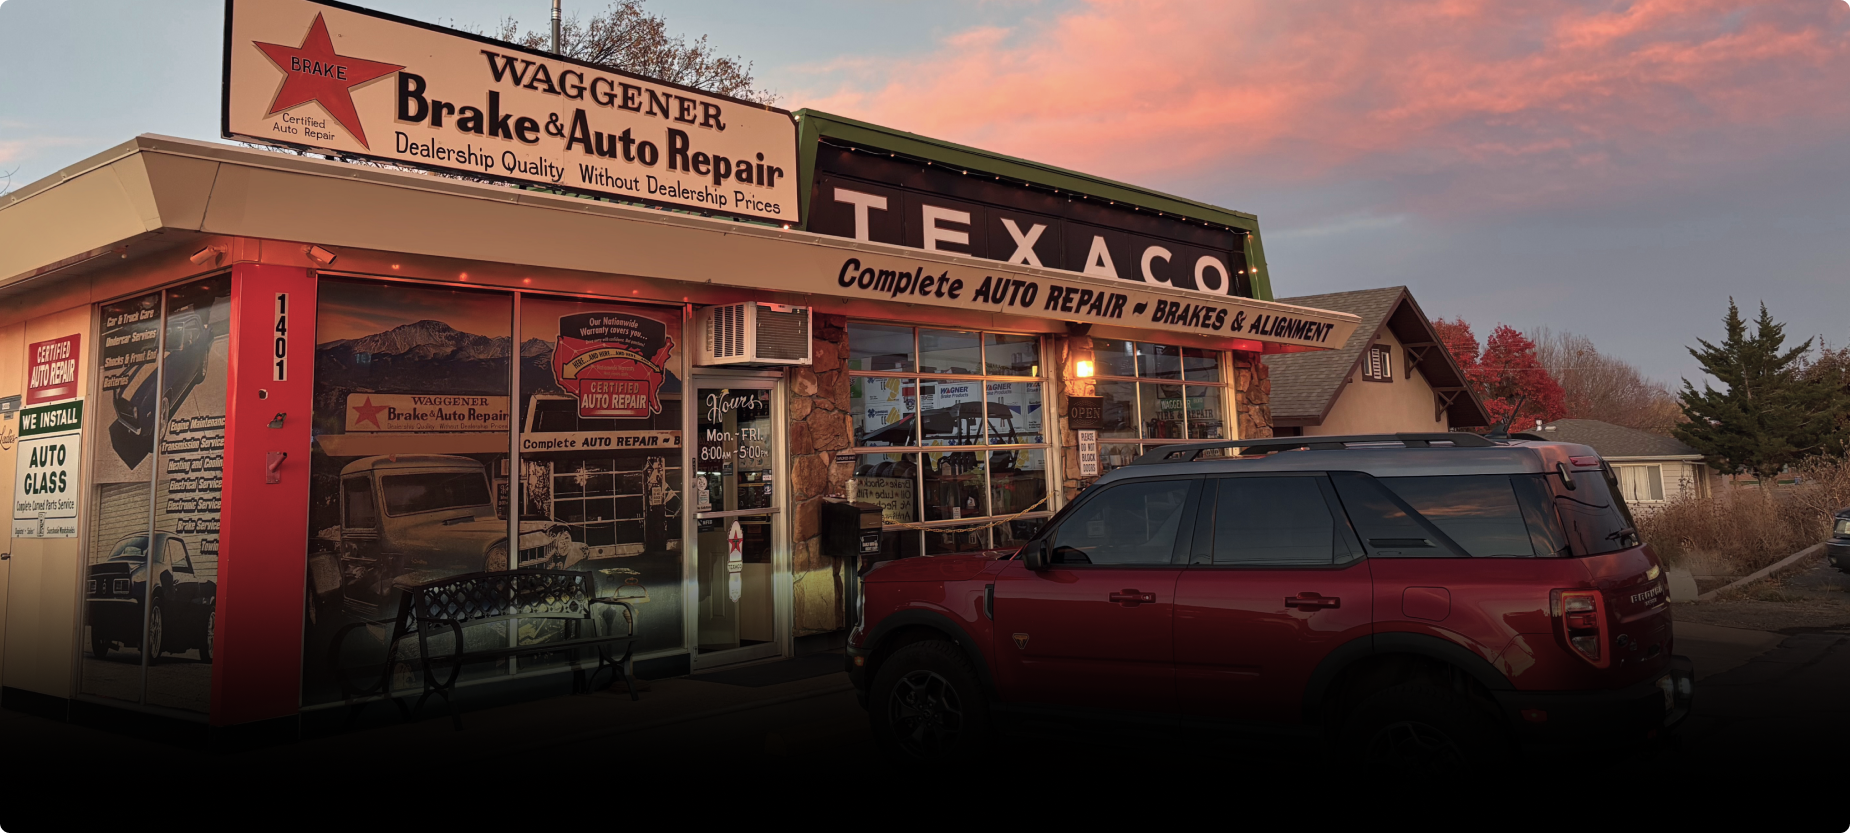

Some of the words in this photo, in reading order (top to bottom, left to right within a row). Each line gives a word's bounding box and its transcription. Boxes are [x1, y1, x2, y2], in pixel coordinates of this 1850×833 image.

[291, 55, 348, 81] BRAKE
[480, 49, 726, 131] WAGGENER
[282, 112, 326, 130] Certified
[396, 72, 541, 145] Brake
[566, 108, 659, 167] Auto
[667, 128, 784, 188] Repair
[272, 121, 299, 138] Auto
[304, 126, 336, 142] Repair
[394, 132, 495, 176] Dealership
[501, 150, 564, 182] Quality
[579, 163, 640, 191] Without
[646, 175, 728, 208] Dealership
[734, 190, 781, 214] Prices
[834, 188, 1230, 297] TEXACO
[838, 258, 964, 300] Complete
[974, 275, 1038, 308] AUTO
[1044, 284, 1128, 319] REPAIR
[1151, 299, 1228, 332] BRAKES
[1230, 310, 1248, 333] &
[1250, 313, 1335, 344] ALIGNMENT
[106, 316, 118, 328] Car
[123, 311, 139, 324] Truck
[140, 308, 154, 320] Care
[589, 317, 602, 326] Our
[603, 316, 638, 329] Nationwide
[106, 332, 132, 348] Undercar
[131, 329, 157, 343] Services
[276, 293, 288, 381] 1401
[580, 326, 609, 337] Warranty
[37, 341, 70, 364] CERTIFIED
[104, 355, 124, 368] Shocks
[147, 348, 158, 360] End
[30, 364, 50, 388] AUTO
[50, 359, 76, 386] REPAIR
[103, 375, 130, 390] Batteries
[590, 382, 640, 394] CERTIFIED
[411, 396, 489, 406] WAGGENER
[581, 394, 609, 409] AUTO
[612, 394, 646, 409] REPAIR
[706, 393, 763, 425] Hours
[22, 413, 37, 430] WE
[40, 408, 78, 428] INSTALL
[388, 407, 428, 421] Brake
[436, 408, 465, 421] Auto
[468, 408, 508, 422] Repair
[1071, 407, 1101, 418] OPEN
[170, 419, 190, 434] Engine
[190, 416, 225, 432] Maintenanc
[162, 438, 200, 454] Transmission
[523, 437, 576, 451] Complete
[582, 436, 612, 448] AUTO
[616, 435, 658, 448] REPAIR
[29, 444, 66, 468] AUTO
[168, 458, 191, 474] Heating
[191, 456, 204, 472] and
[1082, 454, 1095, 462] BLOCK
[24, 470, 67, 496] GLASS
[169, 477, 198, 492] Electrical
[46, 499, 57, 510] Parts
[58, 498, 74, 510] Service
[166, 498, 197, 513] Electronic
[176, 518, 196, 534] Brake
